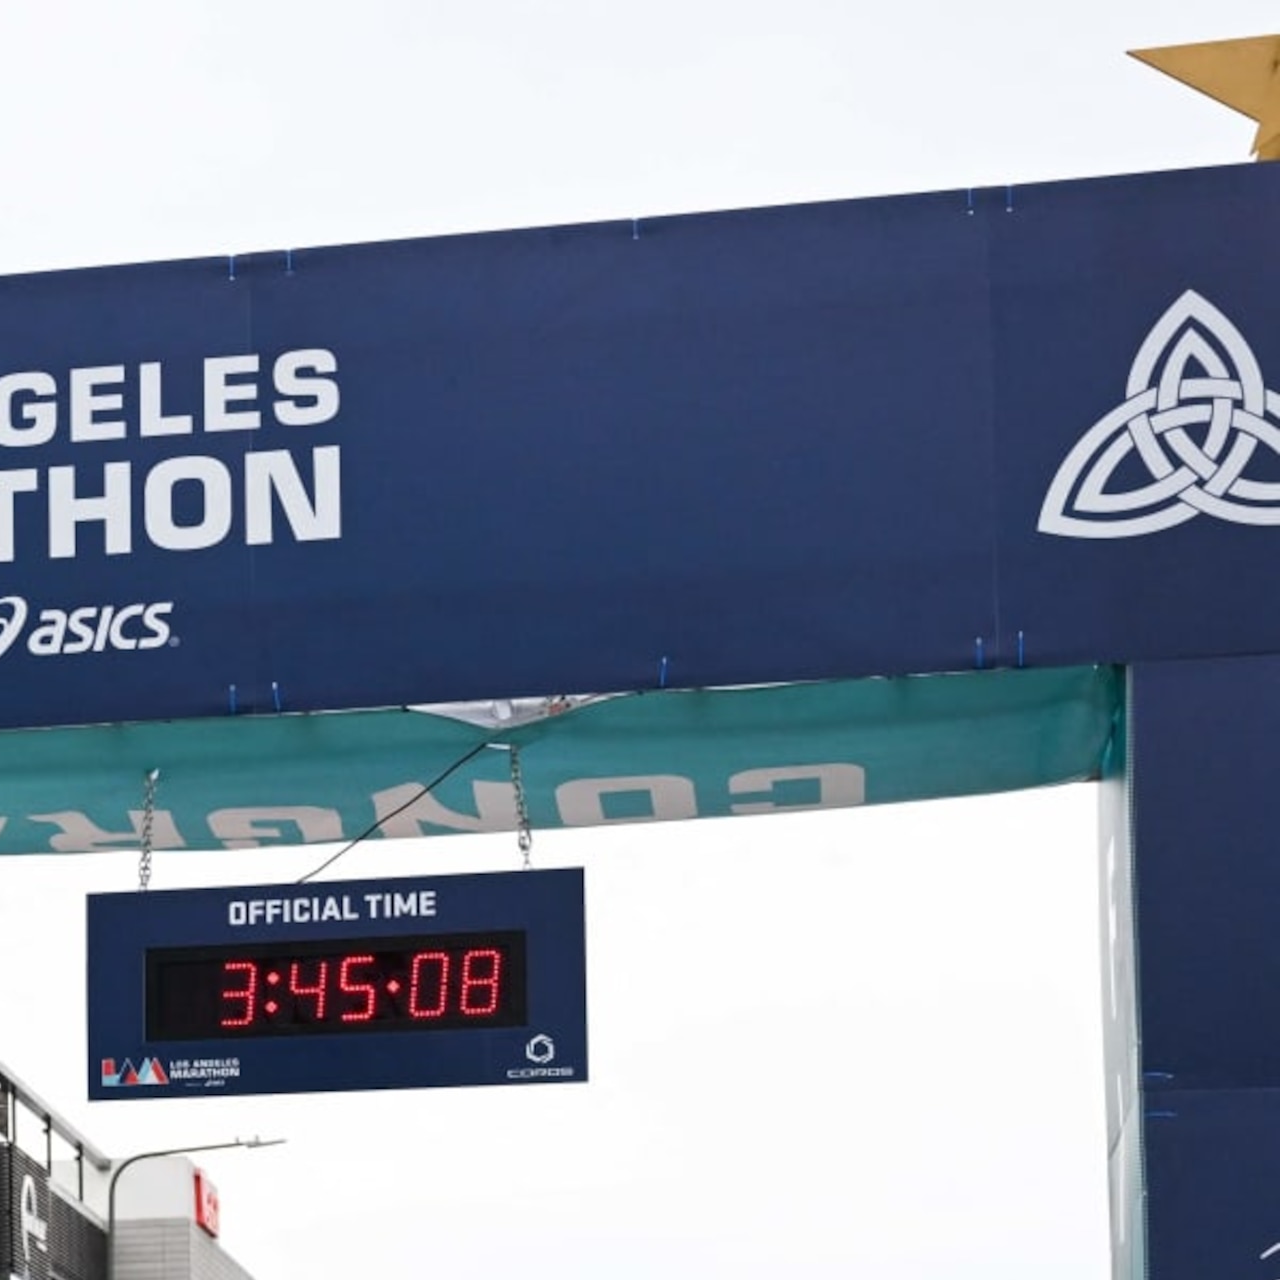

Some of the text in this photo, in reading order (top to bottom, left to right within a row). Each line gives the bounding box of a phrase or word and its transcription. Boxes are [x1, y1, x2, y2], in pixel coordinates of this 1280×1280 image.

[229, 891, 437, 926] OFFICIAL TIME
[220, 949, 501, 1028] 3:45:08
[169, 1058, 240, 1070] LOS ANGELES
[169, 1067, 241, 1080] MARATHON
[507, 1067, 574, 1079] COROS
